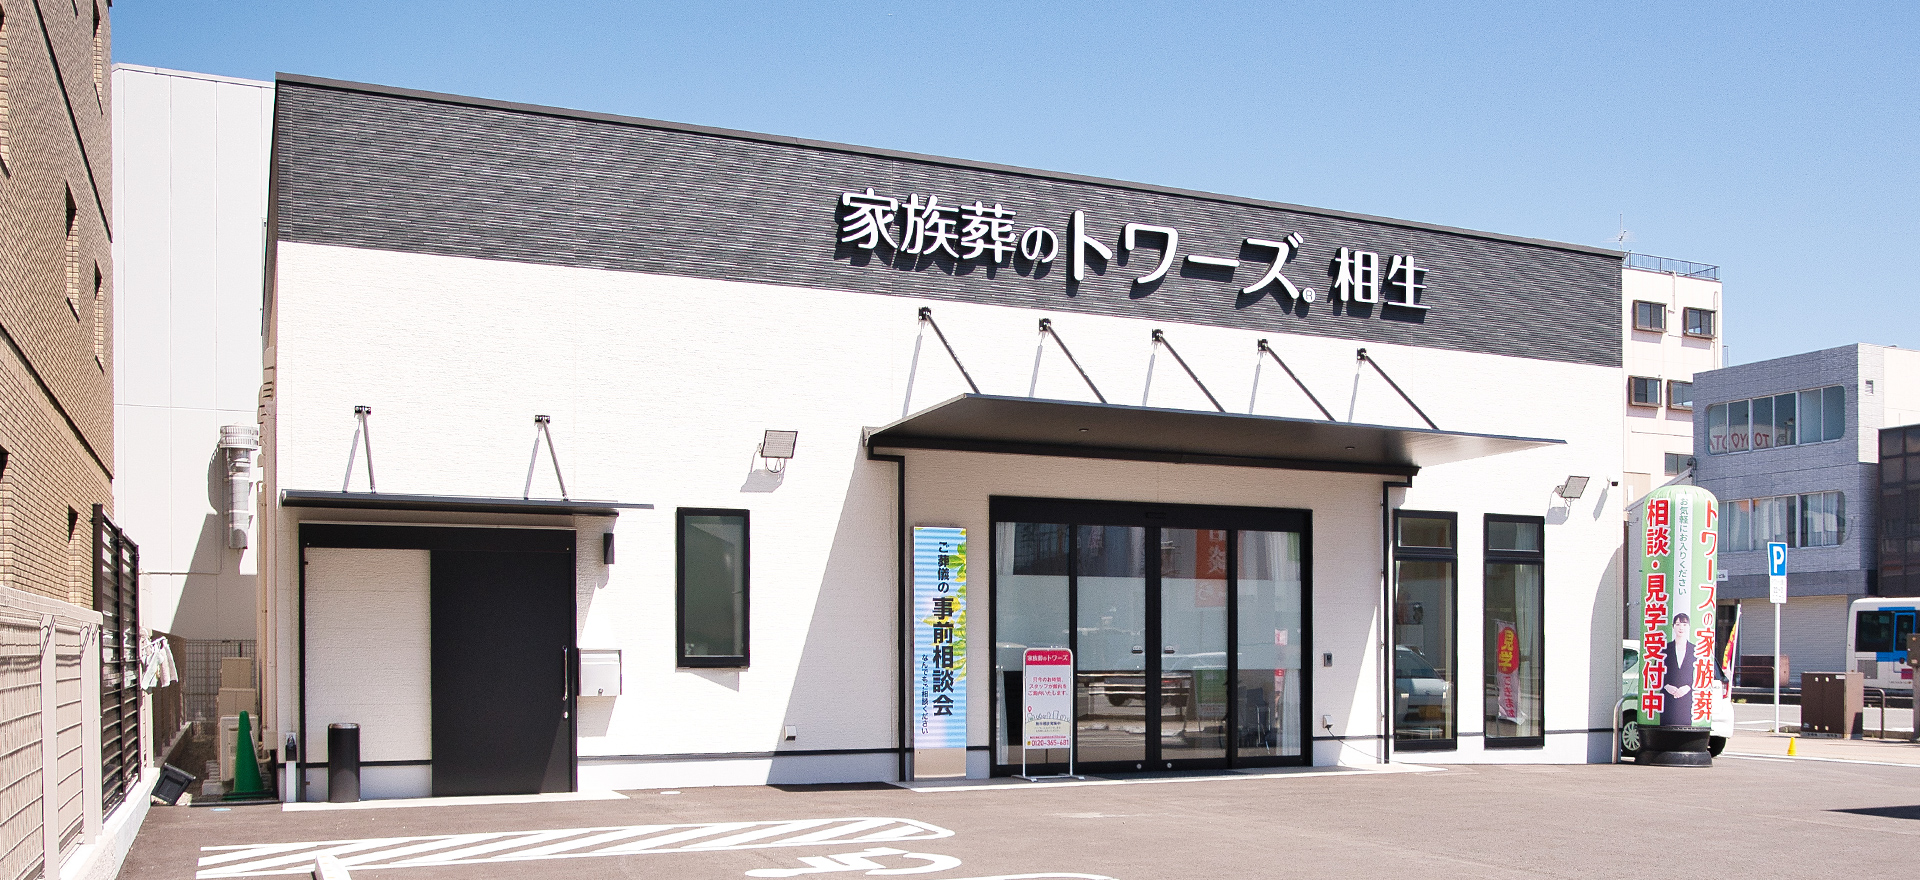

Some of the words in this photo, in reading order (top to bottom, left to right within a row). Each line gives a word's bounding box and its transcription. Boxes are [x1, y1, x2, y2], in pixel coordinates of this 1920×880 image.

[1335, 246, 1431, 310] 相生
[1679, 498, 1688, 595] お気軽にお入りください
[1773, 547, 1784, 573] P
[1642, 499, 1669, 718] 相談・見学受付中
[1694, 500, 1717, 720] トワーズの家族葬
[921, 654, 929, 735] なんでもご相談ください
